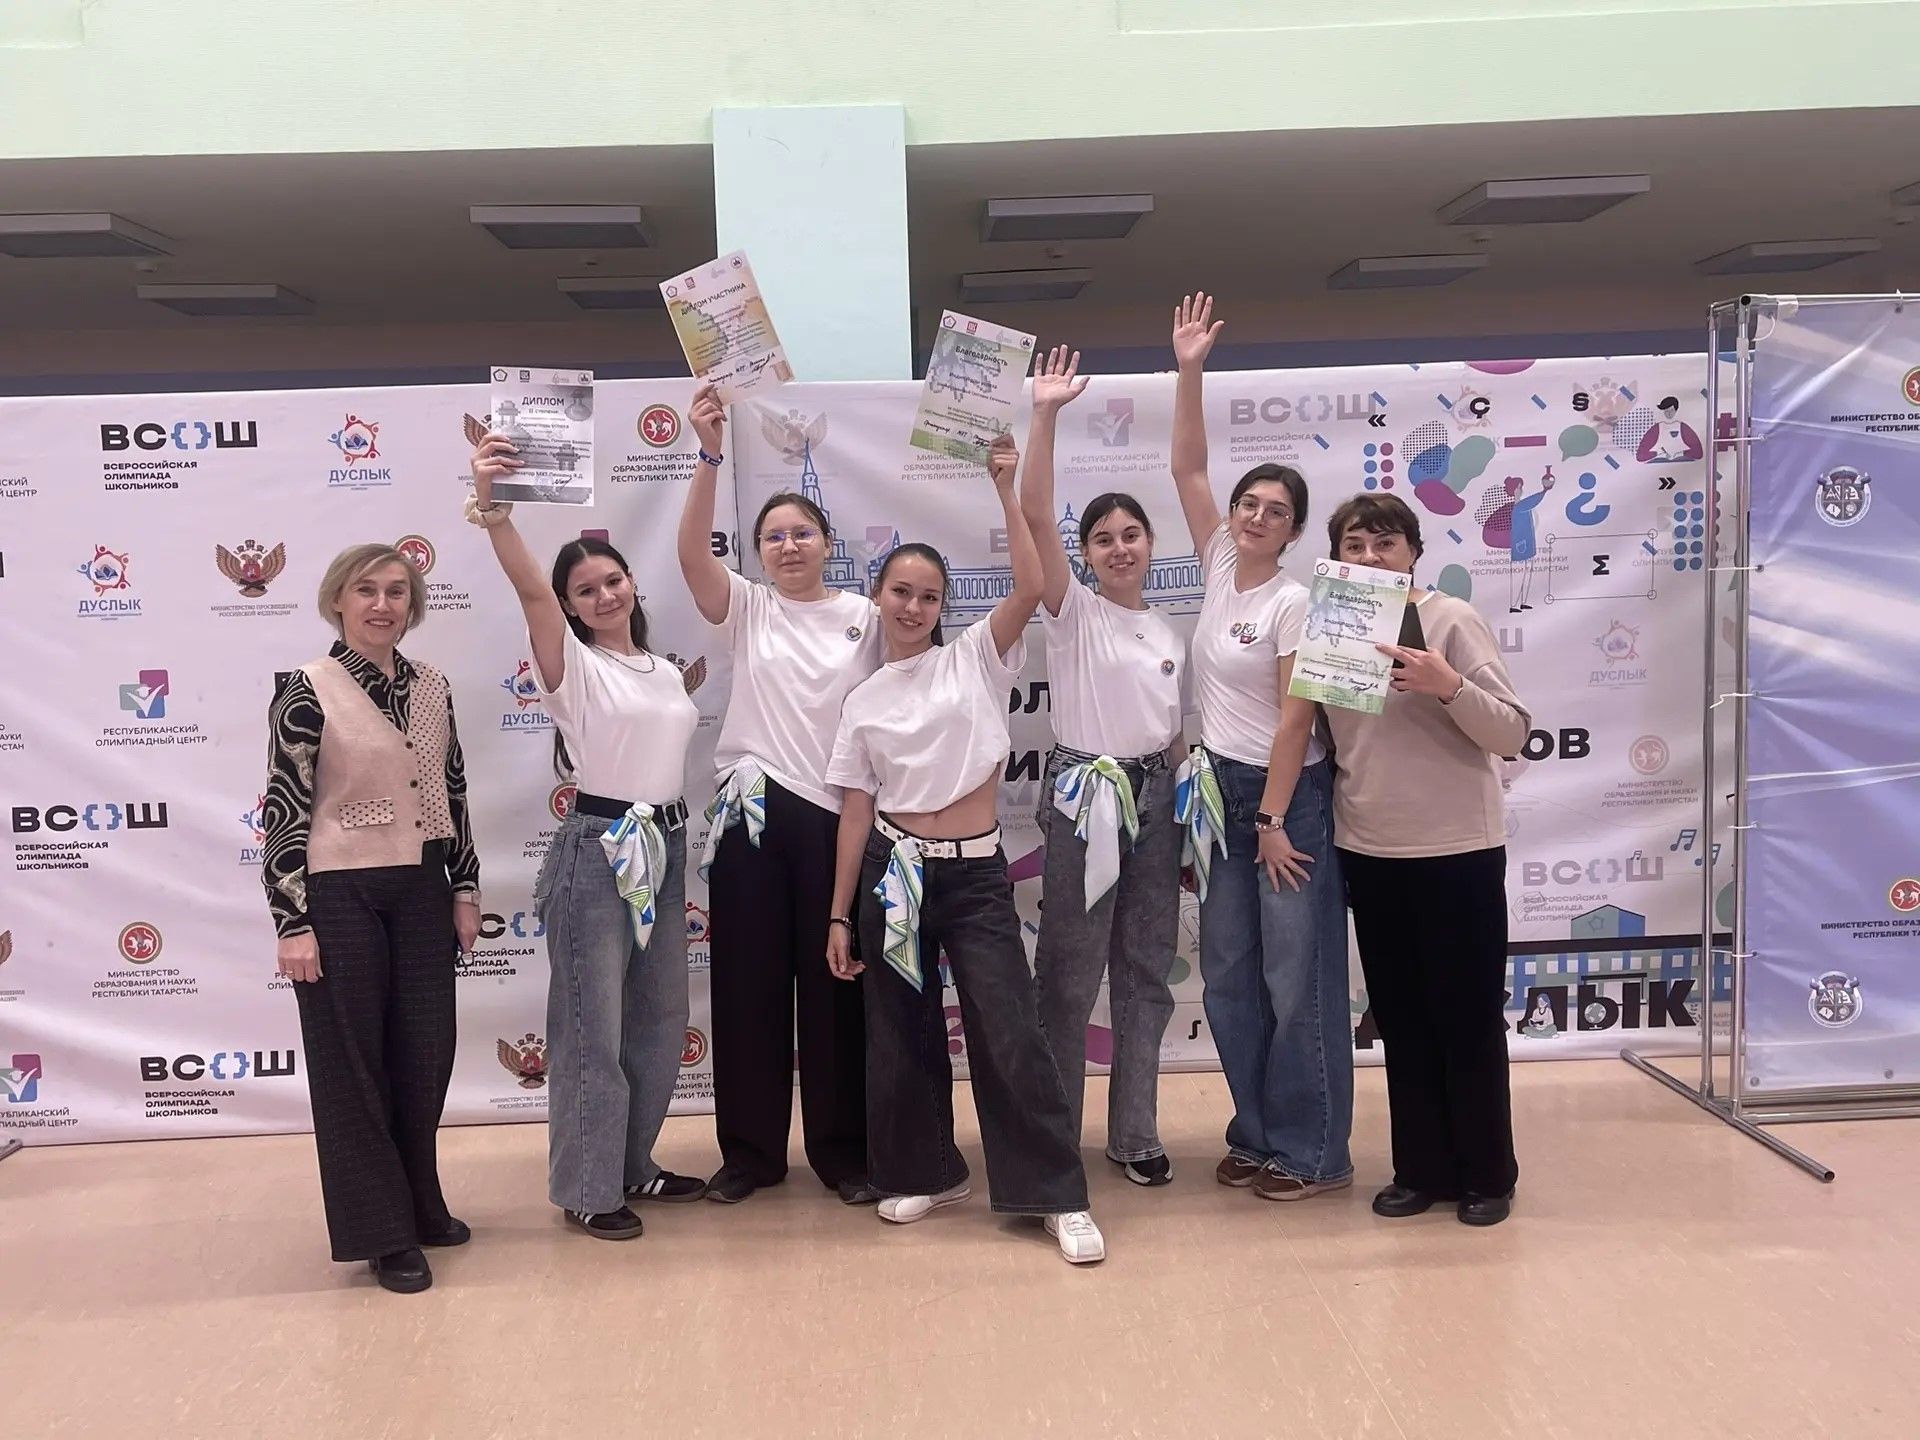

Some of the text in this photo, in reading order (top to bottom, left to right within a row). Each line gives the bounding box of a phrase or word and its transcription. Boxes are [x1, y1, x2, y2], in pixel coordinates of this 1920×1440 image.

[521, 396, 565, 406] ДИПЛОМ
[1830, 413, 1905, 423] МИНИСТЕРСТВО
[1230, 444, 1293, 453] ОЛИМПИАДА
[627, 453, 698, 462] МИНИСТЕРСТВО
[1071, 451, 1160, 463] РЕСПУБЛИКАНСКИЙ
[1230, 453, 1299, 463] ШКОЛЬНИКОВ
[103, 460, 198, 471] ВСЕРОССИЙСКАЯ
[613, 464, 676, 473] ОБРАЗОВАНИЯ
[1063, 463, 1168, 474] ОЛИМПИАДНЫЙ ЦЕНТР
[104, 472, 172, 481] ОЛИМПИАДА
[329, 468, 392, 483] ДУСЛЫК
[610, 474, 668, 483] РЕСПУБЛИКИ
[105, 481, 179, 491] ШКОЛЬНИКОВ
[6, 489, 38, 498] ЦЕНТР
[441, 592, 469, 601] НАУКИ
[79, 598, 142, 613] ДУСЛЫК
[1589, 669, 1648, 684] ДУСЛЫК
[103, 724, 199, 735] РЕСПУБЛИКАНСКИЙ
[95, 735, 208, 747] ОЛИМПИАДНЫЙ ЦЕНТР
[1617, 780, 1683, 789] МИНИСТЕРСТВО
[1604, 788, 1662, 798] ОБРАЗОВАНИЯ
[1601, 797, 1699, 808] РЕСПУБЛИКИ ТАТАРСТАН
[15, 840, 109, 851] ВСЕРОССИЙСКАЯ
[15, 852, 82, 861] ОЛИМПИАДА
[16, 861, 89, 870] ШКОЛЬНИКОВ
[1821, 920, 1890, 930] МИНИСТЕРСТВО
[1853, 930, 1909, 939] РЕСПУБЛИКИ
[107, 969, 180, 979] МИНИСТЕРСТВО
[93, 979, 157, 989] ОБРАЗОВАНИЯ
[167, 978, 196, 986] НАУКИ
[92, 988, 198, 999] РЕСПУБЛИКИ ТАТАРСТАН
[145, 1089, 235, 1099] ВСЕРОССИЙСКАЯ
[145, 1099, 211, 1108] ОЛИМПИАДА
[145, 1108, 218, 1118] ШКОЛЬНИКОВ
[47, 1118, 79, 1128] ЦЕНТР
